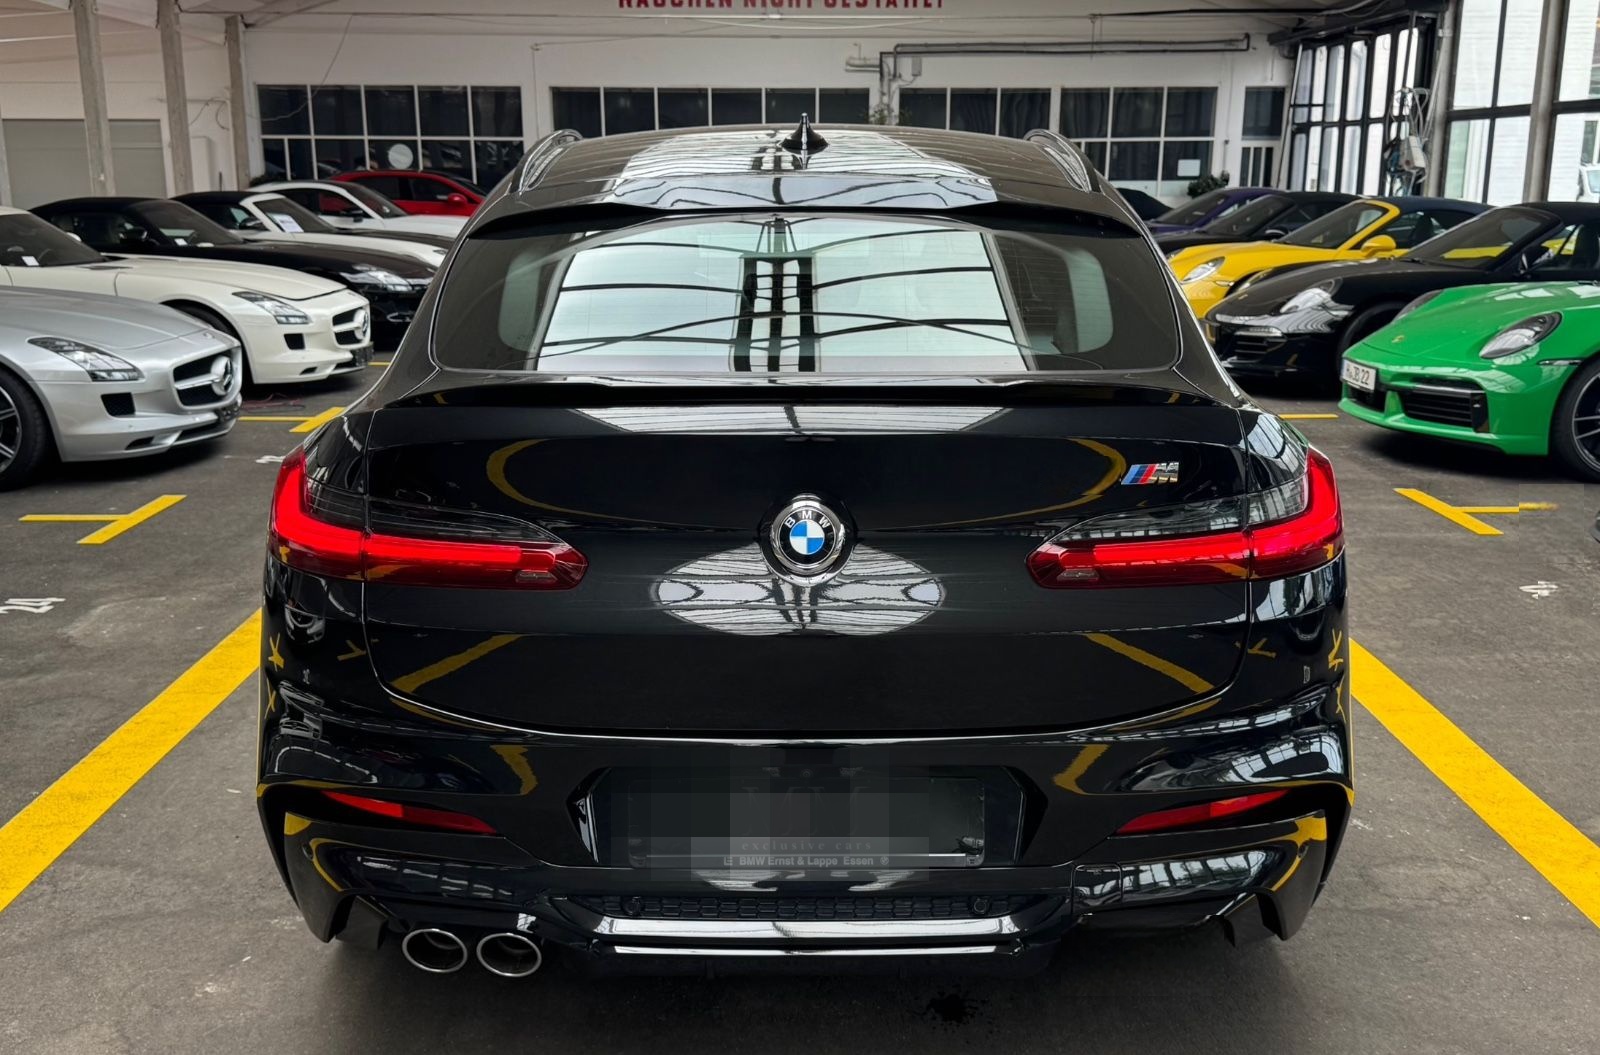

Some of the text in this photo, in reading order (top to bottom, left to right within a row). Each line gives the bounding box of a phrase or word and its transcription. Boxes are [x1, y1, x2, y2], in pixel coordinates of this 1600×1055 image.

[784, 510, 830, 529] BMW
[742, 840, 872, 851] exclusive cars
[739, 857, 765, 866] BMW
[768, 857, 795, 866] Ernst
[797, 857, 805, 866] &
[808, 857, 838, 868] Lappe
[843, 857, 874, 866] Essen
